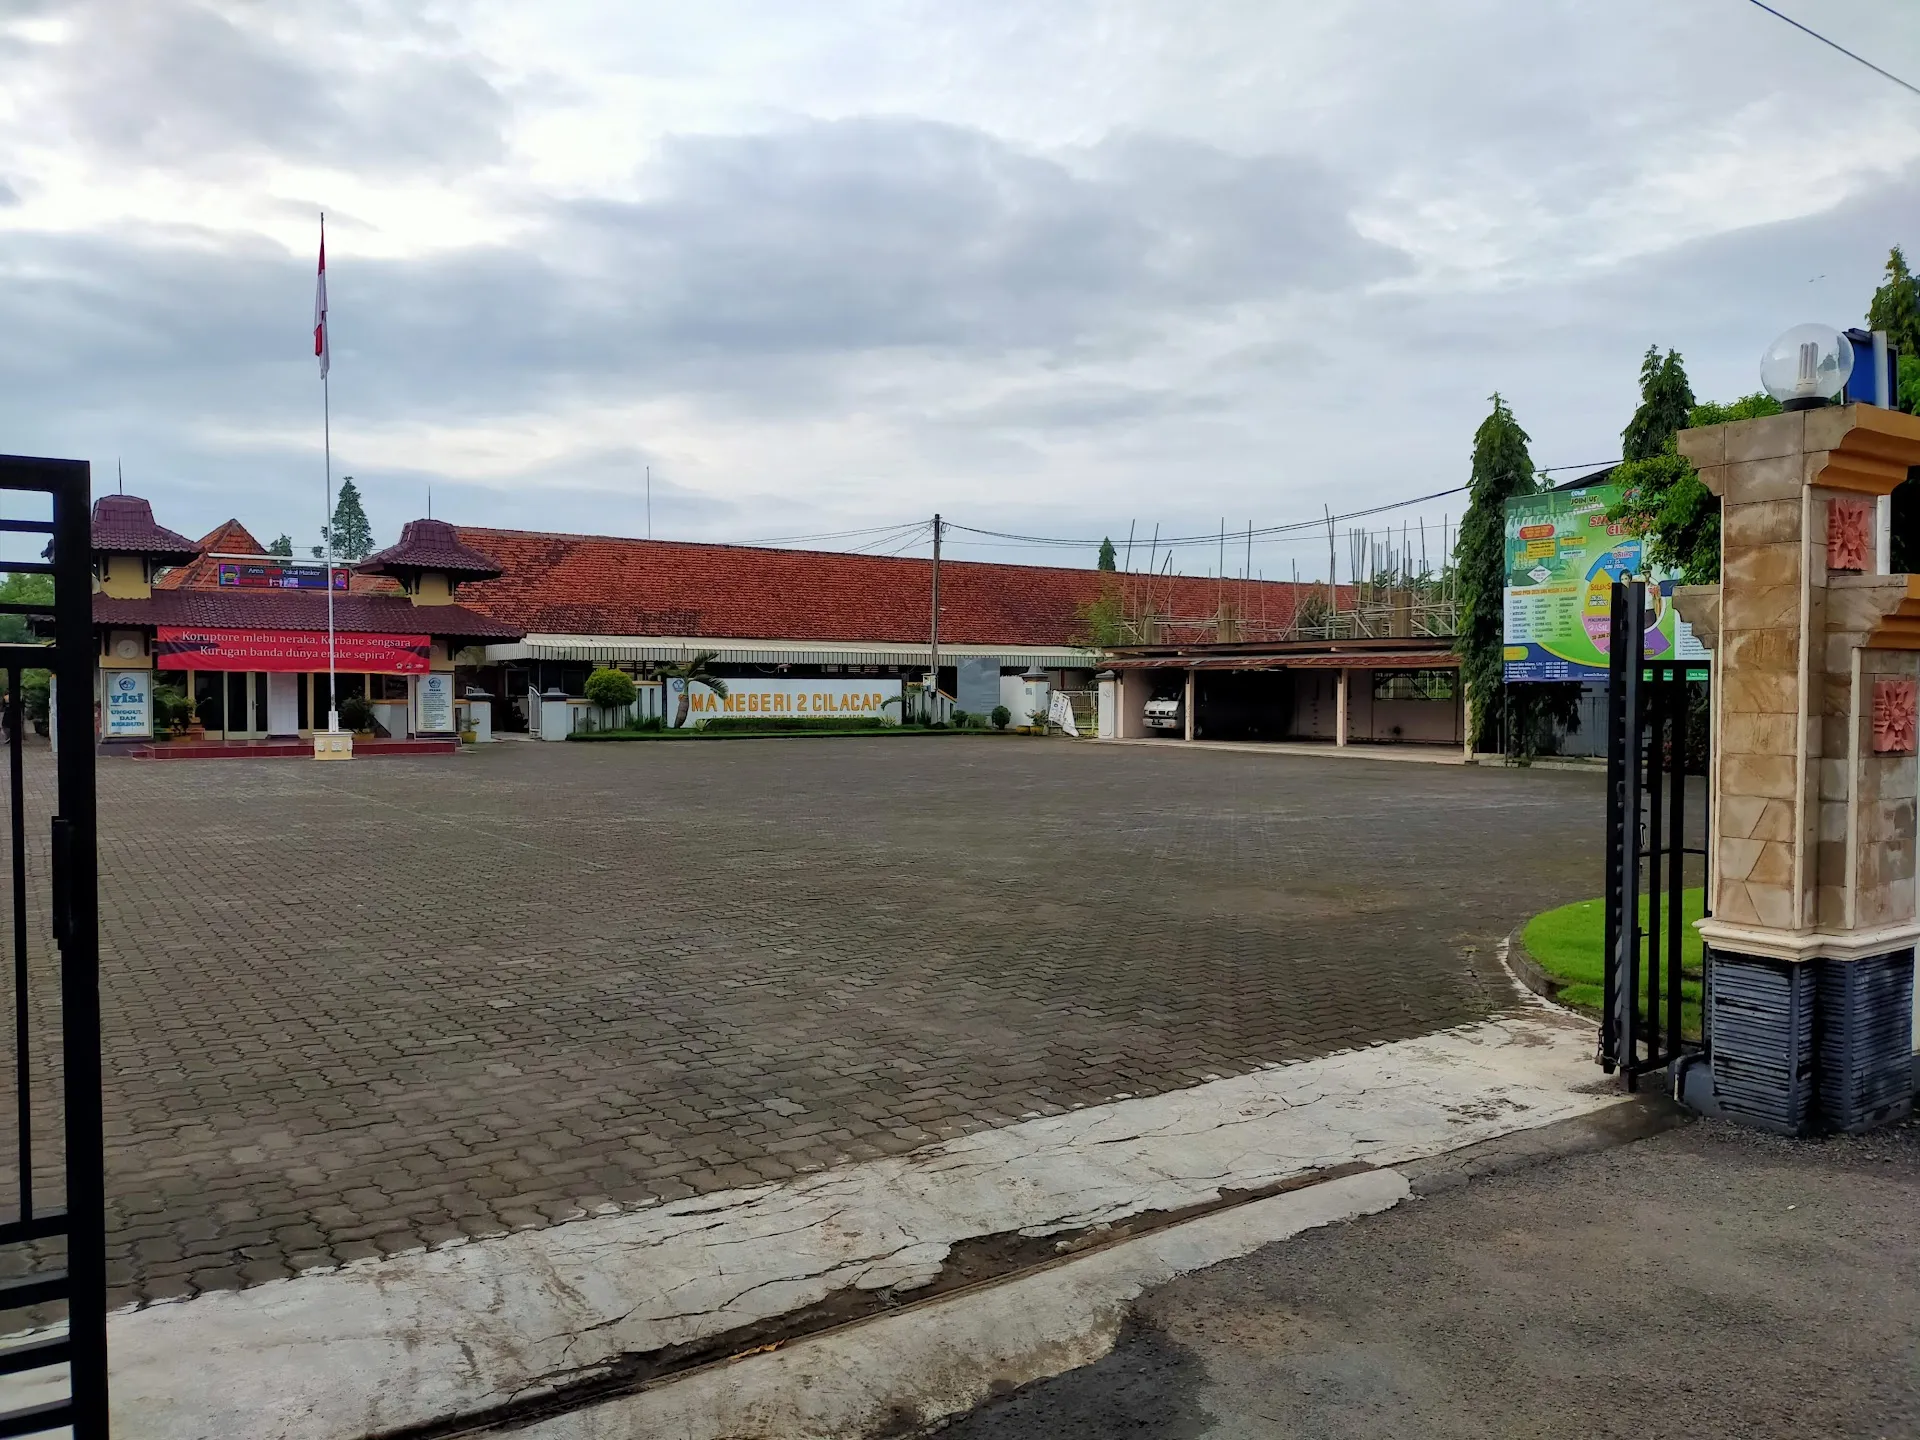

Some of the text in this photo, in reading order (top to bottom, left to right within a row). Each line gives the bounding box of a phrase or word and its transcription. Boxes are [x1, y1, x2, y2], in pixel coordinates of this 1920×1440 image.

[1571, 497, 1587, 505] JOIN
[182, 631, 240, 643] Koruptore
[242, 633, 276, 643] mlebu
[279, 635, 319, 645] neraka,
[366, 639, 411, 648] sengsara
[200, 646, 247, 657] Kurugan
[250, 648, 283, 658] banda
[285, 649, 319, 660] dunya
[353, 651, 396, 661] sepira??
[723, 693, 792, 712] NEGERI
[797, 693, 808, 712] 2
[812, 693, 882, 712] CILACAP
